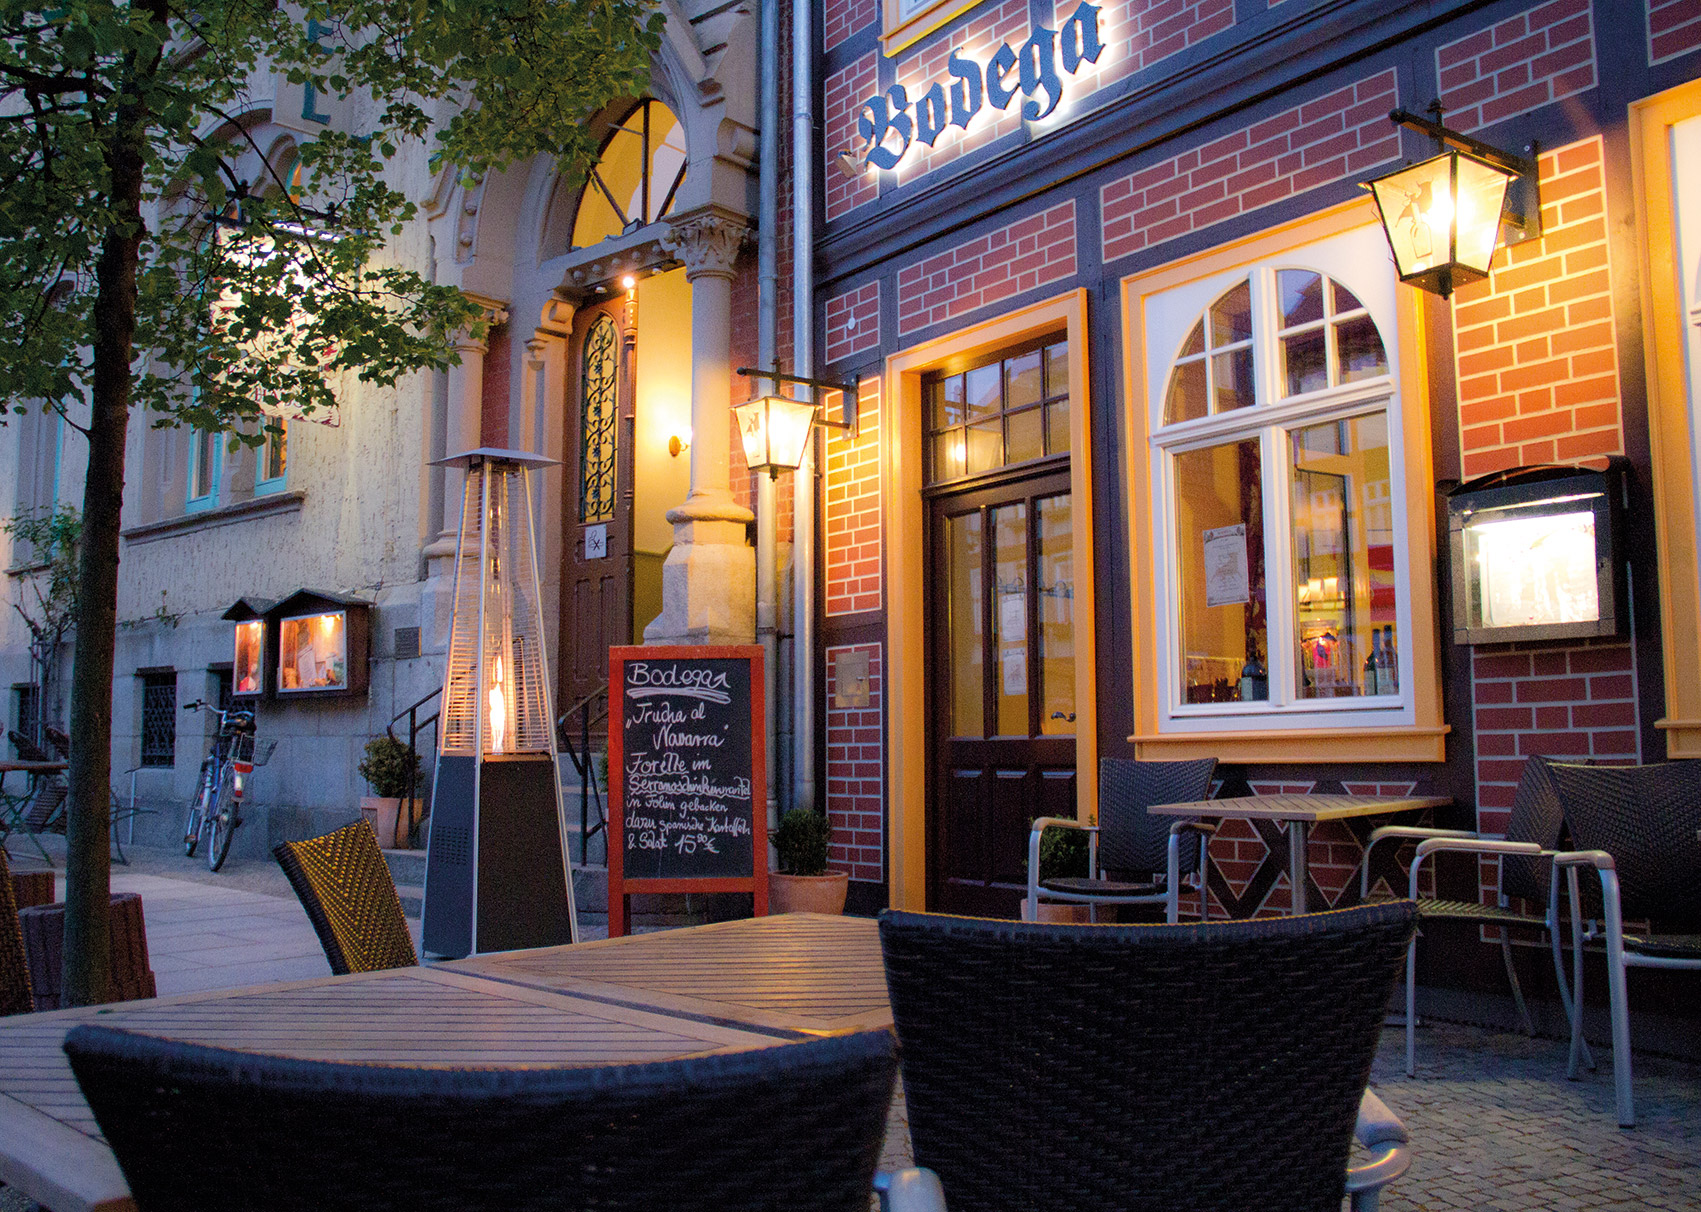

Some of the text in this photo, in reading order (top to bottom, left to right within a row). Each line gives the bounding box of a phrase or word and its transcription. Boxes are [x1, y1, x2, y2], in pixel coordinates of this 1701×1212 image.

[858, 1, 1106, 172] Bodega
[690, 701, 706, 720] al
[626, 752, 712, 774] Forelle im
[626, 795, 642, 808] in
[679, 797, 729, 819] gebacken
[625, 811, 657, 829] dazu
[639, 830, 668, 849] Salat
